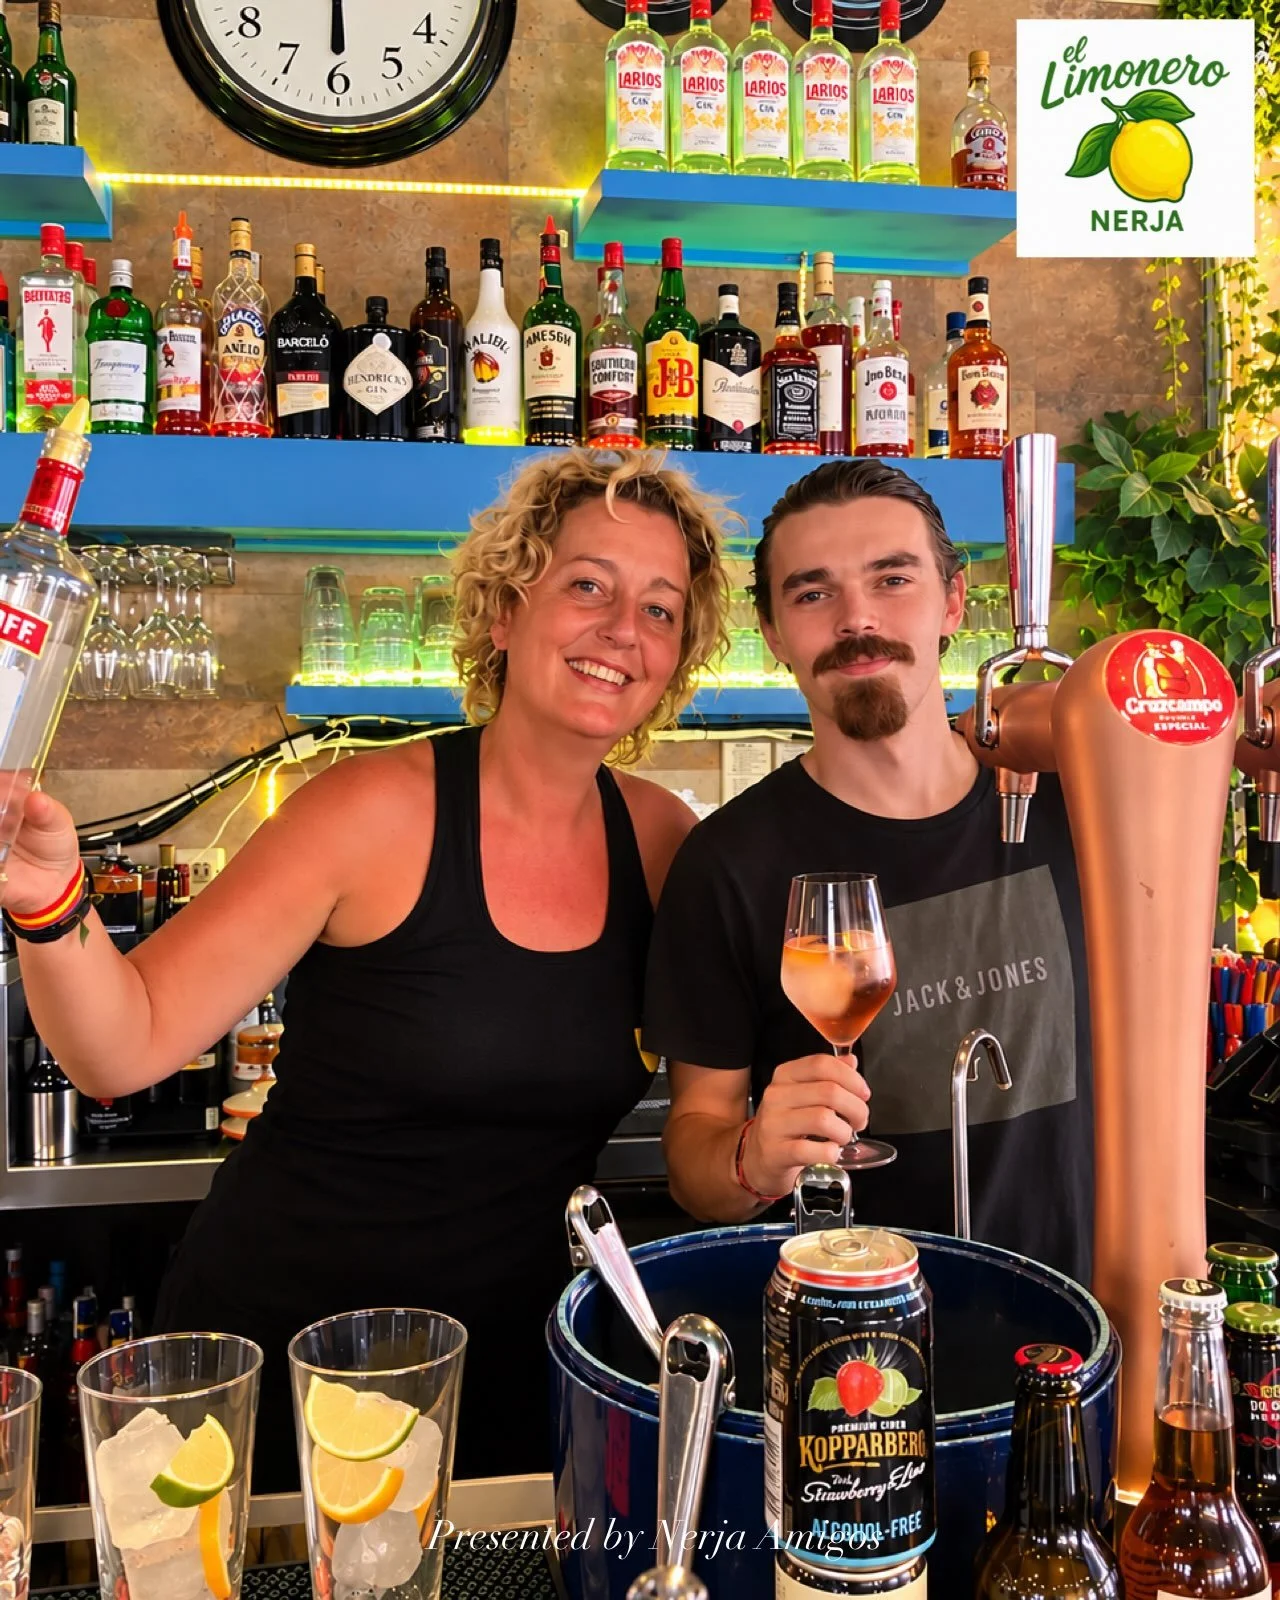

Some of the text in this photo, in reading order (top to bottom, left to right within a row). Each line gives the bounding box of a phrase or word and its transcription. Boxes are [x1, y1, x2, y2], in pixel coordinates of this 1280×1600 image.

[238, 6, 262, 38] 8
[412, 12, 437, 44] 4
[278, 42, 300, 75] 7
[381, 46, 403, 80] 5
[326, 61, 351, 95] 6
[618, 71, 662, 90] LARIOS
[683, 76, 725, 95] LARIOS
[745, 79, 787, 98] LARIOS
[806, 83, 848, 101] LARIOS
[873, 87, 915, 105] LARIOS
[893, 957, 1048, 1016] JACK & JONES
